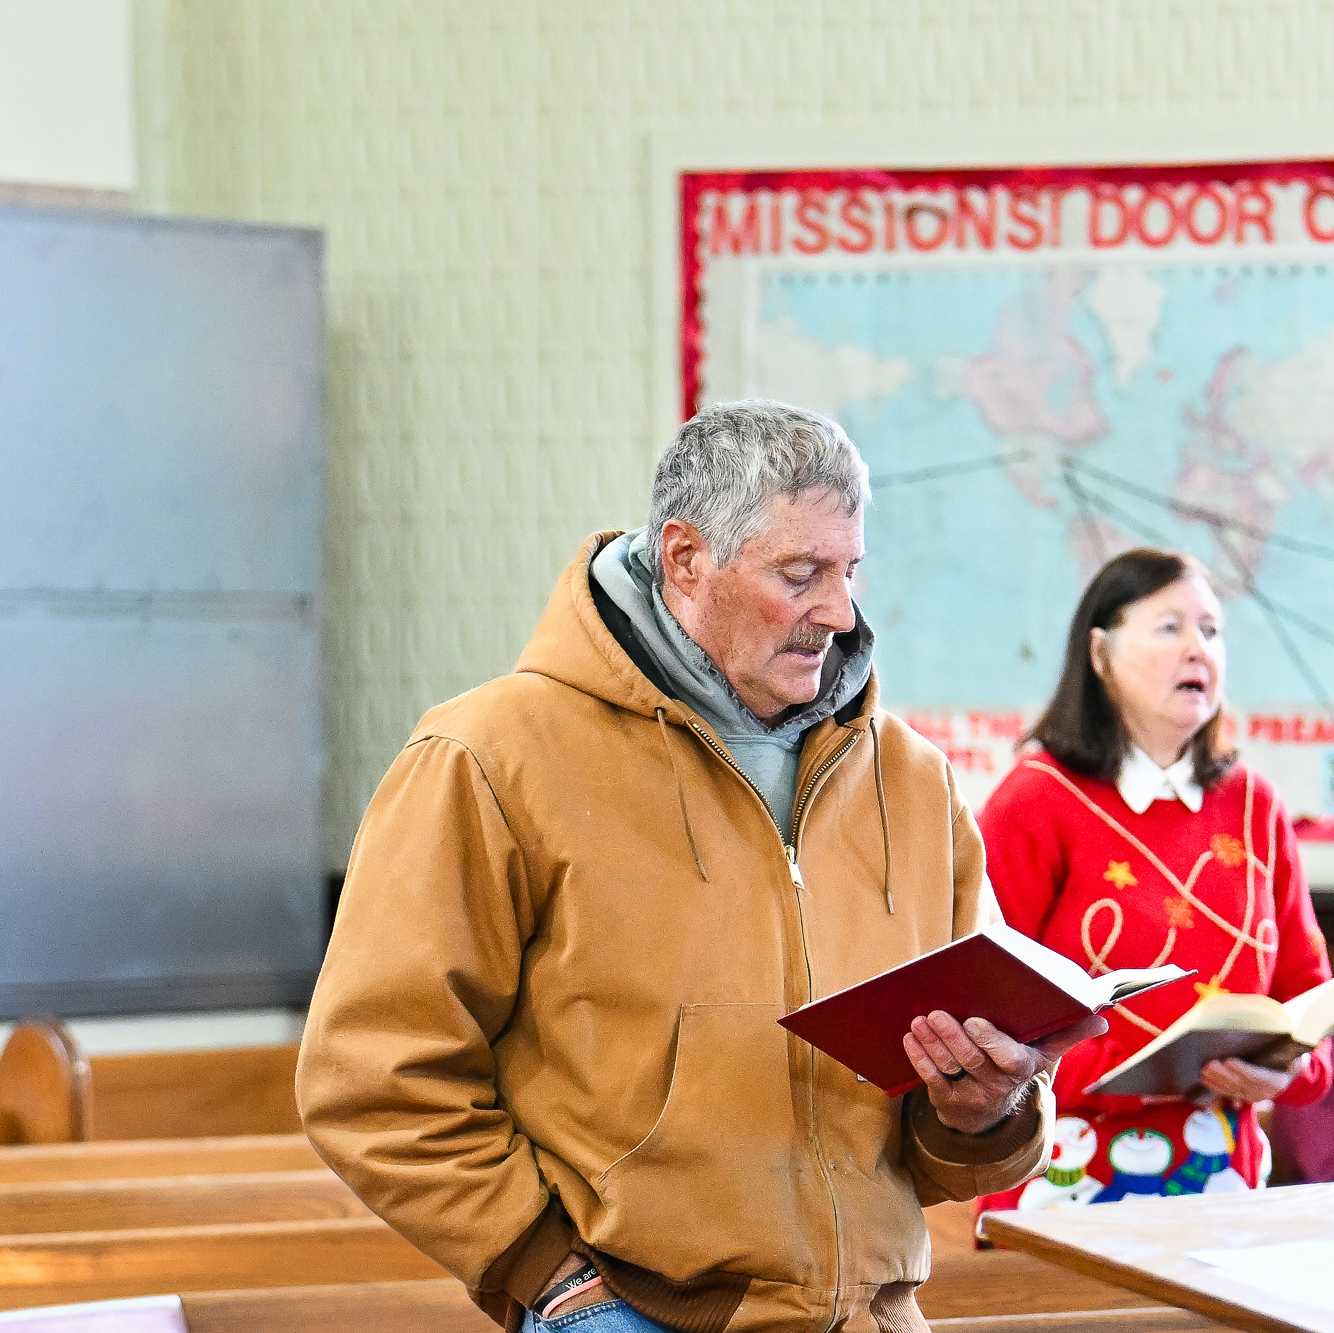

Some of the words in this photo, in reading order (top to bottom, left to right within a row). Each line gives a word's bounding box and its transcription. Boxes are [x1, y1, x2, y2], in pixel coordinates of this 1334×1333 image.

[1089, 186, 1273, 248] DOOR
[565, 1277, 583, 1290] We
[582, 1267, 597, 1281] are
